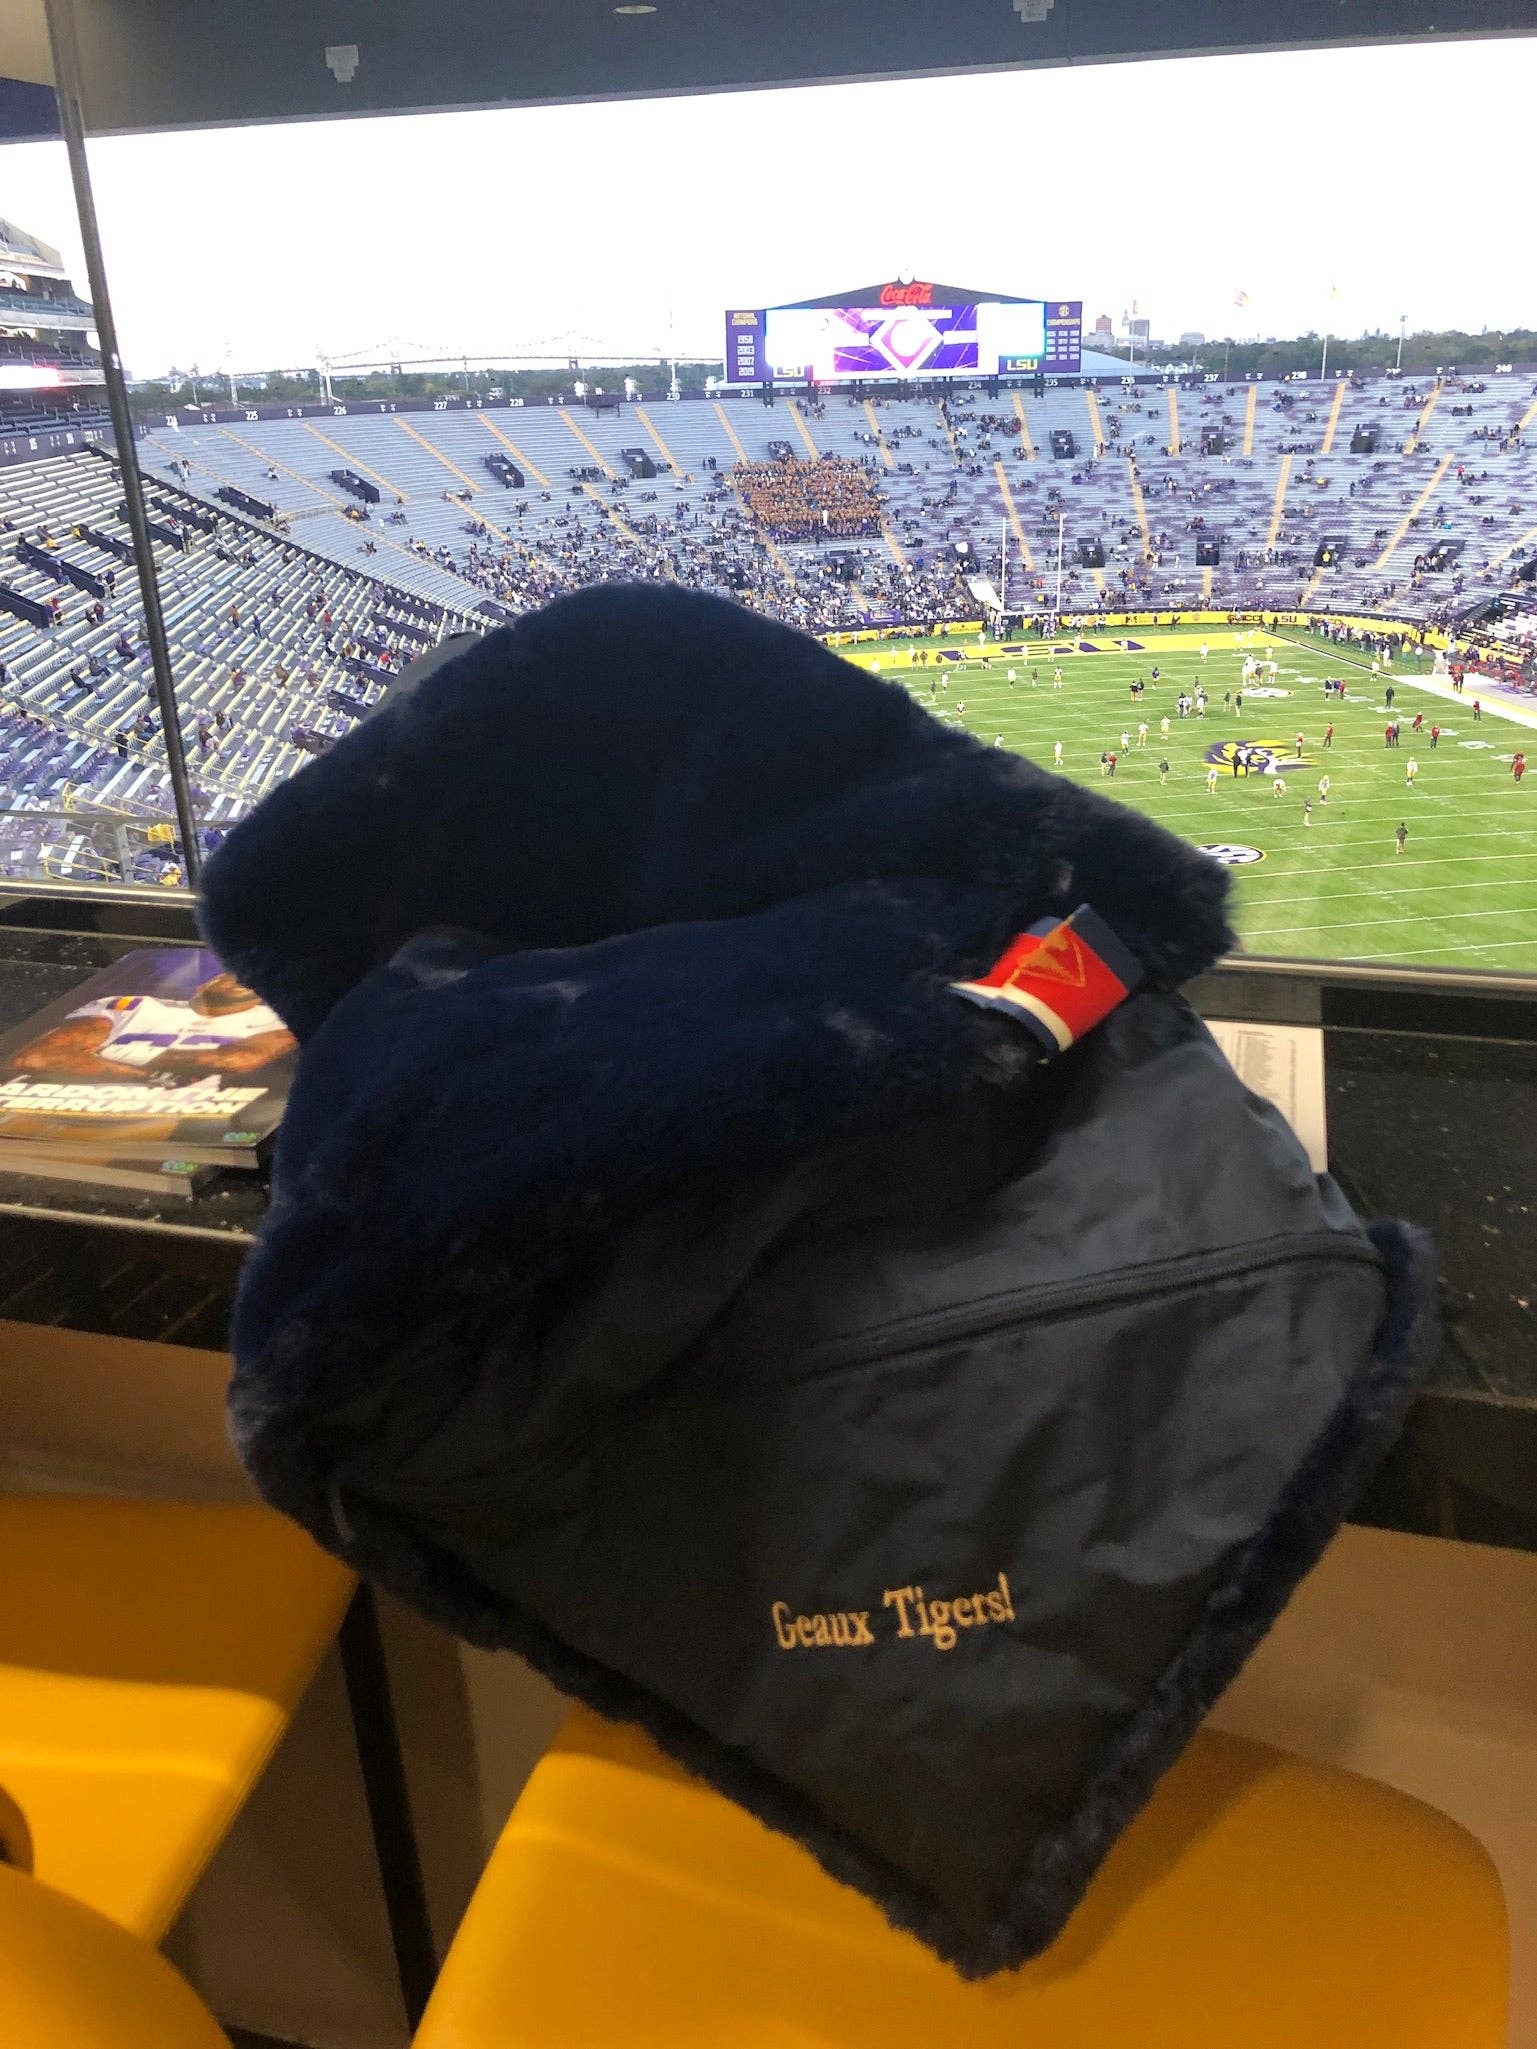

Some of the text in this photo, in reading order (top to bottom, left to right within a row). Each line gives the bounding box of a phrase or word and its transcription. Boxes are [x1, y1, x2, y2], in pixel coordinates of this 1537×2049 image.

[1007, 359, 1038, 371] LSU
[1204, 374, 1219, 382] 237
[967, 381, 982, 389] 234
[1044, 379, 1058, 387] 235
[817, 387, 832, 395] 232
[434, 401, 448, 410] 227
[509, 398, 524, 407] 228
[333, 406, 347, 416] 226
[245, 411, 259, 421] 225
[772, 1571, 1015, 1650] Geaux Tigers!
